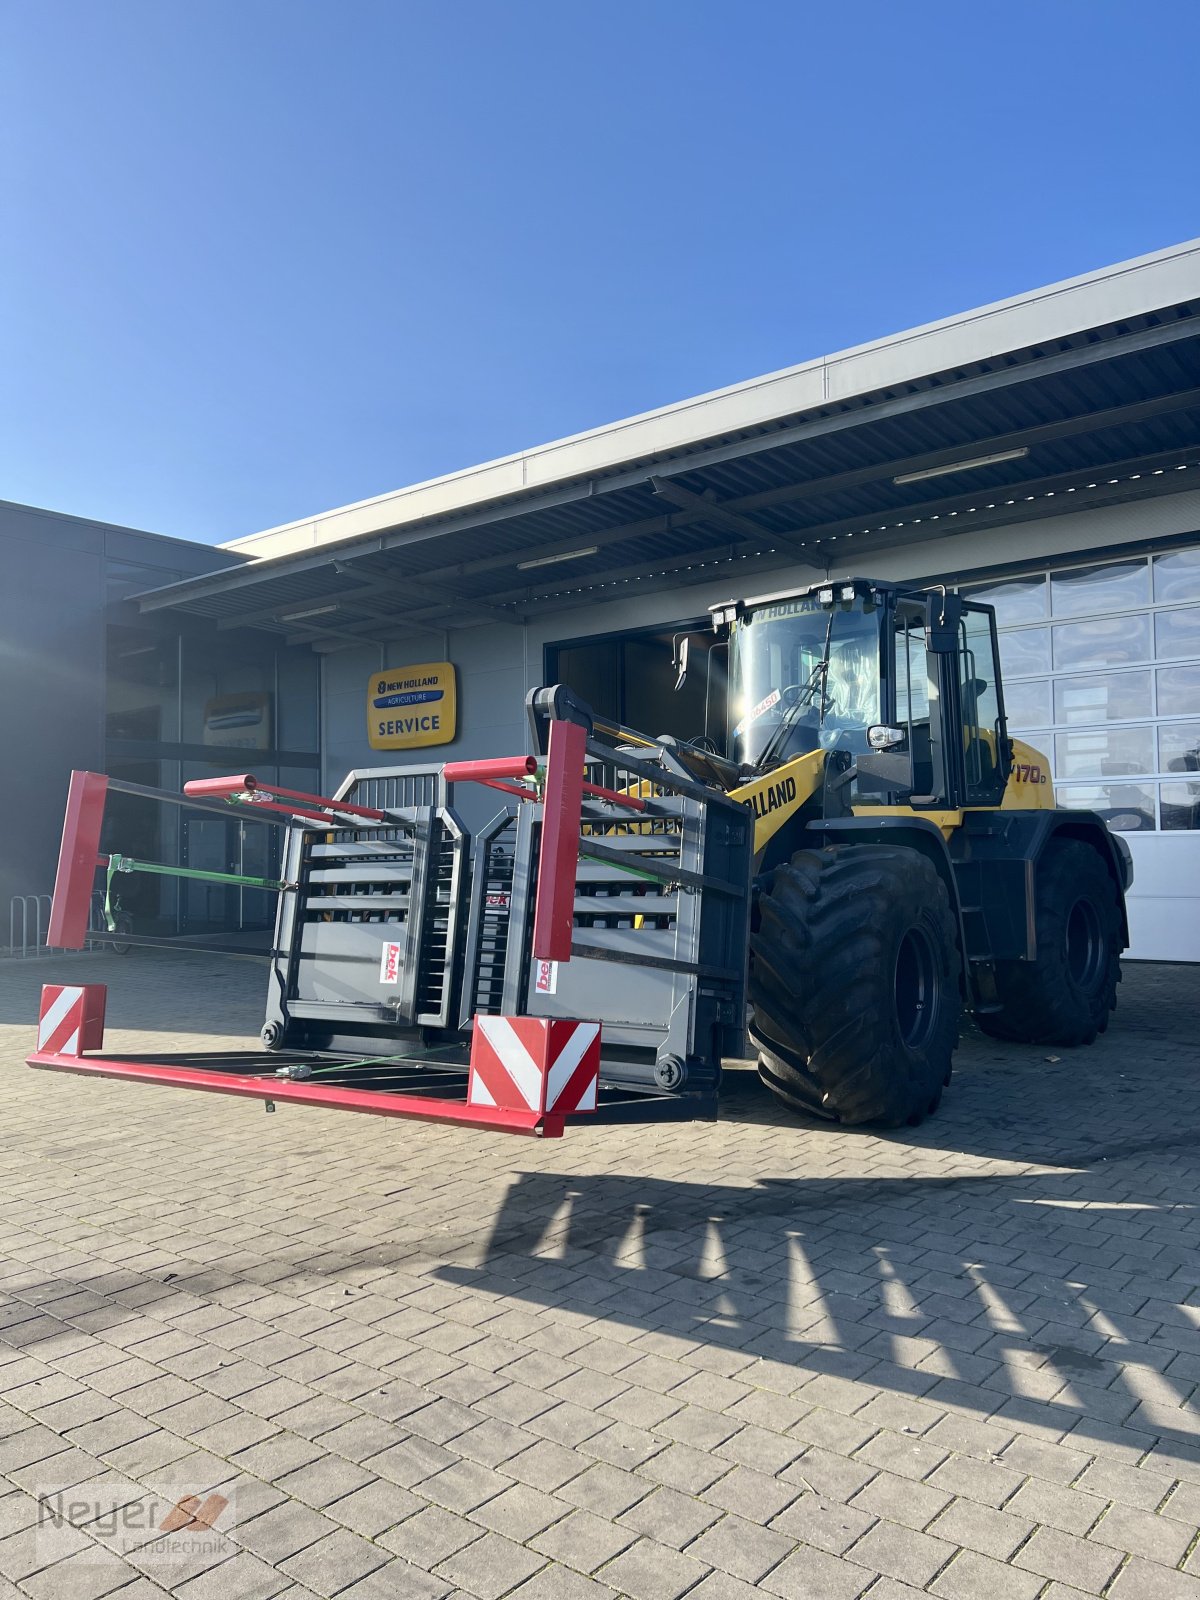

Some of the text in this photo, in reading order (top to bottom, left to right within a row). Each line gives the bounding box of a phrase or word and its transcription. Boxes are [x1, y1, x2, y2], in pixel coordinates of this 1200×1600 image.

[769, 600, 823, 618] HOLLAN
[387, 677, 438, 691] NEW HOLLAND
[388, 693, 427, 705] AGRICULTURE
[379, 715, 440, 736] SERVICE
[388, 944, 400, 981] bek
[537, 960, 549, 991] be
